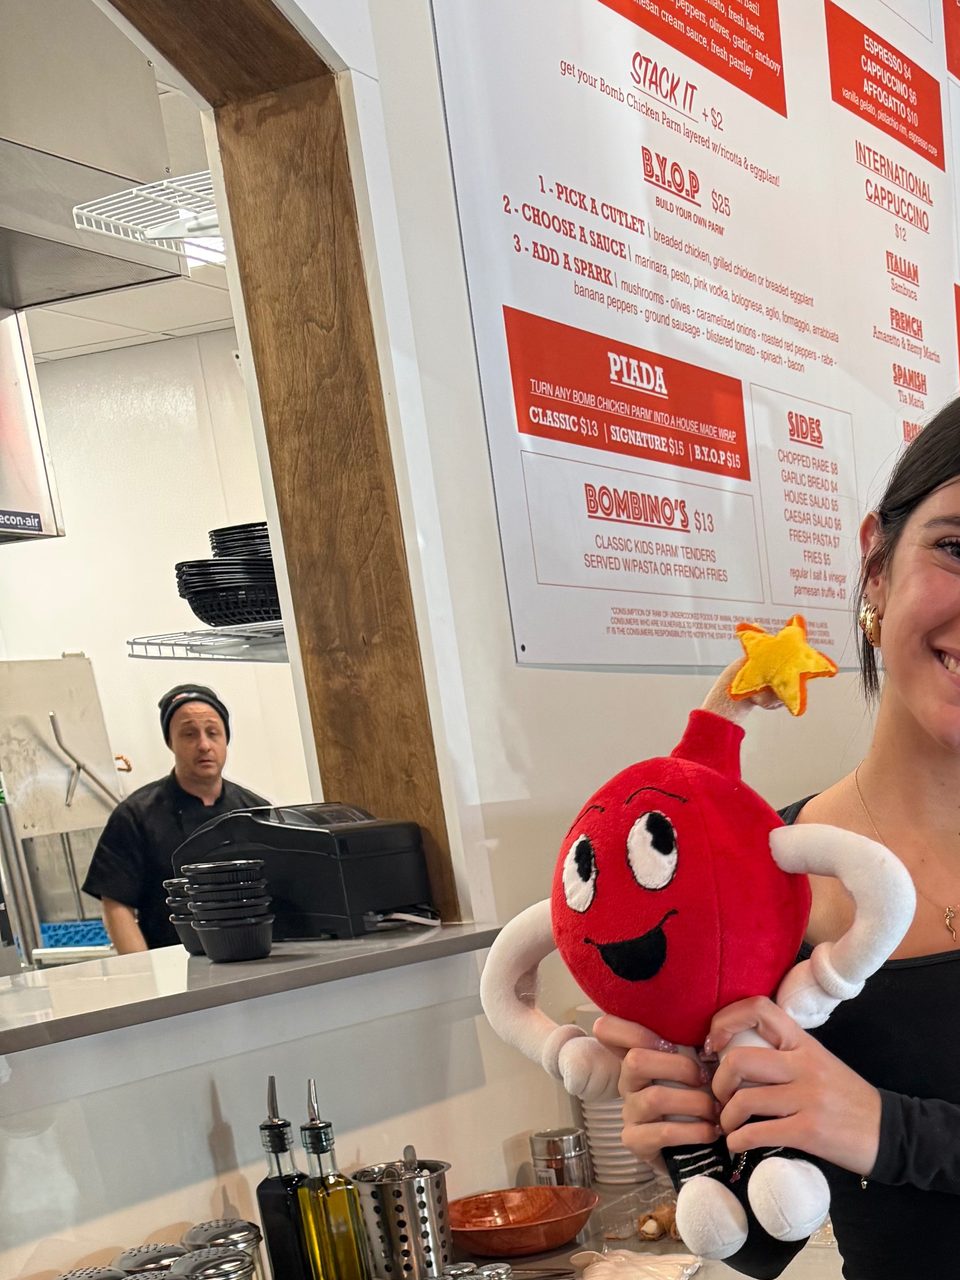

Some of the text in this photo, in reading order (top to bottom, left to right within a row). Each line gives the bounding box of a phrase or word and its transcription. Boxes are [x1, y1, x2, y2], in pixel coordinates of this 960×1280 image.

[660, 9, 754, 80] cream sauce, fresh parsley
[728, 5, 765, 41] fresh herbs
[709, 17, 731, 43] olives,
[732, 34, 754, 58] garlic,
[755, 49, 781, 77] anchovy
[863, 34, 912, 81] ESPRESSO $4
[630, 51, 681, 106] STACK
[682, 80, 698, 113] IT
[710, 107, 724, 131] $2
[861, 55, 908, 99] CAPPUCCINO
[560, 60, 576, 77] get
[577, 68, 599, 89] your
[599, 77, 625, 103] Bomb
[626, 92, 660, 122] Chicken
[661, 111, 681, 134] Parm
[683, 123, 710, 149] layered
[712, 143, 742, 167] w/ricotta
[743, 156, 749, 170] &
[842, 87, 860, 105] vanilla
[860, 98, 877, 118] gelato,
[863, 78, 918, 127] AFFOGATTO $10
[641, 145, 731, 217] B.Y.O.P $25
[855, 139, 933, 204] INTERNATIONAL
[502, 194, 627, 260] 2 CHOOSE A SAUCE
[539, 174, 645, 235] 1 PICK A CUTLET
[655, 196, 707, 229] BUILD YOUR OWN
[865, 178, 929, 231] CAPPUCCINO
[895, 223, 907, 241] $12
[513, 234, 613, 286] 3 ADD A SPARK
[653, 227, 814, 306] breaded chicken, grilled chicken or breaded eggplant
[886, 250, 919, 283] ITALIAN
[635, 253, 669, 278] marinara,
[670, 268, 692, 287] pesto,
[693, 276, 708, 292] pink
[709, 282, 730, 302] vodka,
[731, 289, 764, 315] bolognese,
[782, 310, 811, 334] formaggio,
[574, 281, 805, 373] banana peppers ground sausage blistered tomato spinach bacon
[621, 280, 664, 305] mushrooms
[670, 297, 691, 315] olives
[696, 308, 735, 331] caramelized
[736, 322, 756, 339] onions
[761, 332, 783, 349] roasted
[784, 341, 793, 352] red
[794, 344, 817, 360] peppers
[890, 307, 923, 339] FRENCH
[607, 351, 668, 395] PIADA
[893, 363, 927, 393] SPANISH
[530, 379, 736, 442] TURN ANY BOMB CHICKEN INTO A HOUSE MADE WRAP
[787, 410, 823, 445] SIDES
[529, 406, 741, 469] CLASSIC $13 SIGNATURE $15 B.Y.O.P $15
[778, 449, 829, 473] CHOPPED RABE
[781, 469, 806, 487] GARLIC
[807, 475, 829, 491] BREAD
[784, 489, 830, 510] HOUSE SALAD
[584, 483, 714, 533] BOMBINO'S $13
[784, 508, 833, 529] CAESAR SALAD
[595, 534, 716, 563] CLASSIC KIDS TENDERS
[789, 528, 812, 544] FRESH
[812, 532, 832, 547] PASTA
[803, 549, 822, 564] FRIES
[584, 553, 728, 583] SERVED W/PASTA OR FRENCH FRIES
